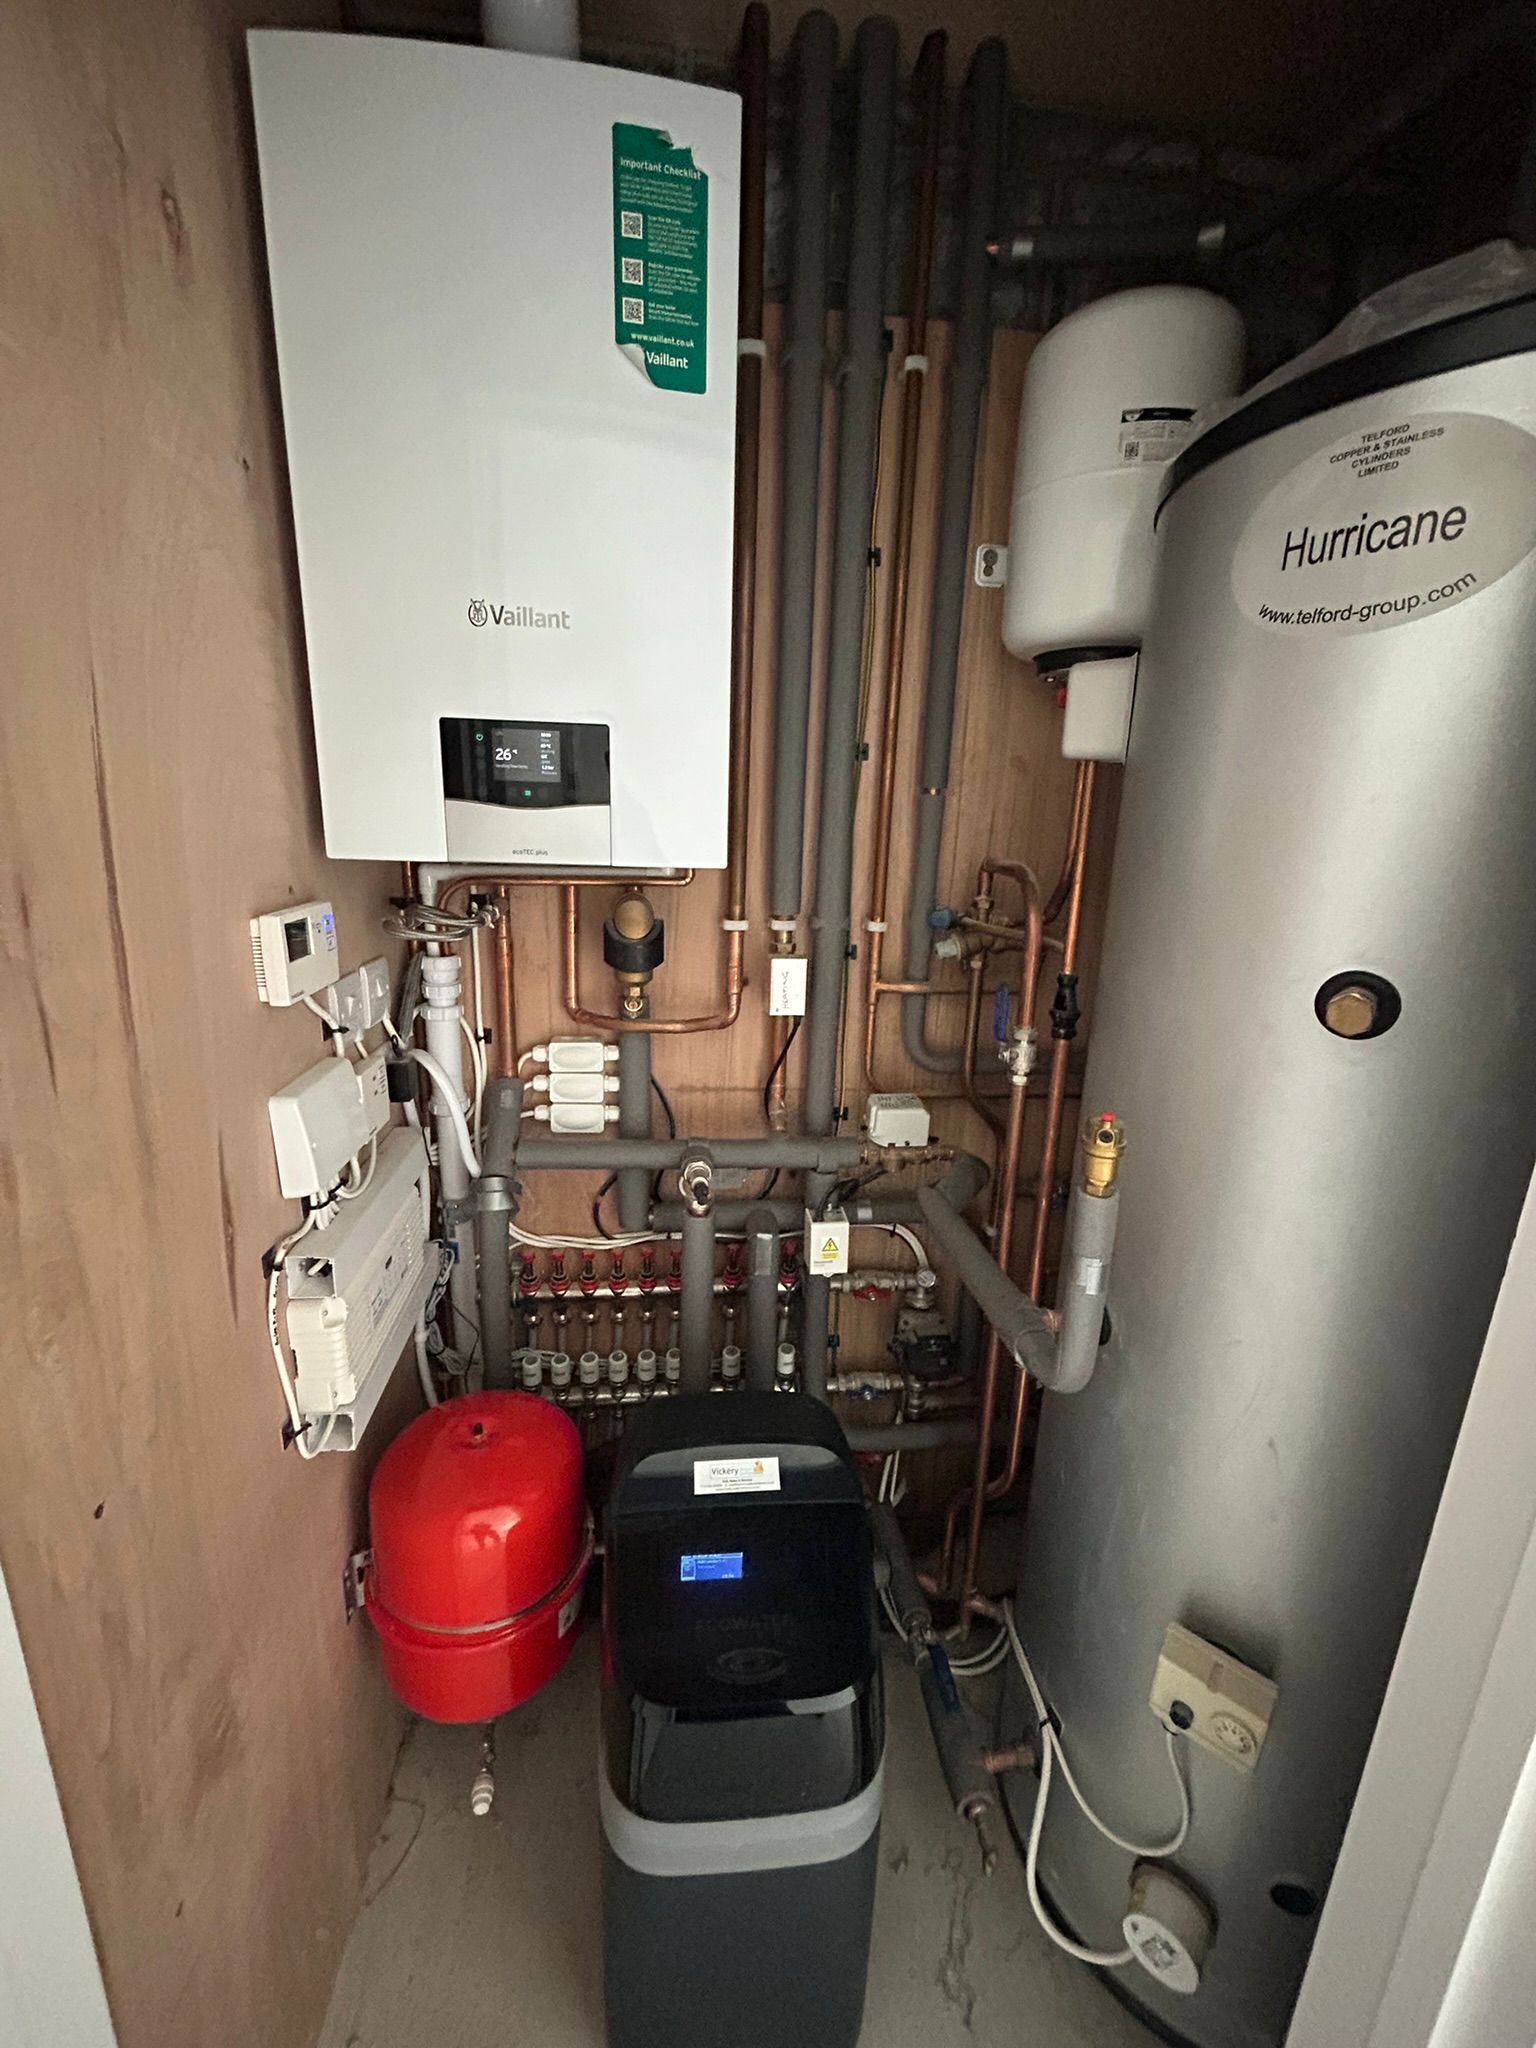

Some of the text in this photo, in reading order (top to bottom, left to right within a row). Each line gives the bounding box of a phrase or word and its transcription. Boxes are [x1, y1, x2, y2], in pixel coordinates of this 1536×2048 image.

[620, 157, 702, 180] Important Checklist
[631, 333, 695, 348] www.vaillant.co.uk
[646, 351, 689, 369] Vaillant
[1361, 423, 1410, 444] TELFORD
[1330, 427, 1445, 464] COPPER & STAINLESS
[1351, 446, 1411, 469] CYLINDERS
[1358, 460, 1399, 478] LIMITED
[1281, 505, 1467, 571] Hurricane
[1258, 572, 1477, 625] www.telford-group.com
[489, 604, 572, 630] Vaillant
[711, 1466, 739, 1476] Vickery
